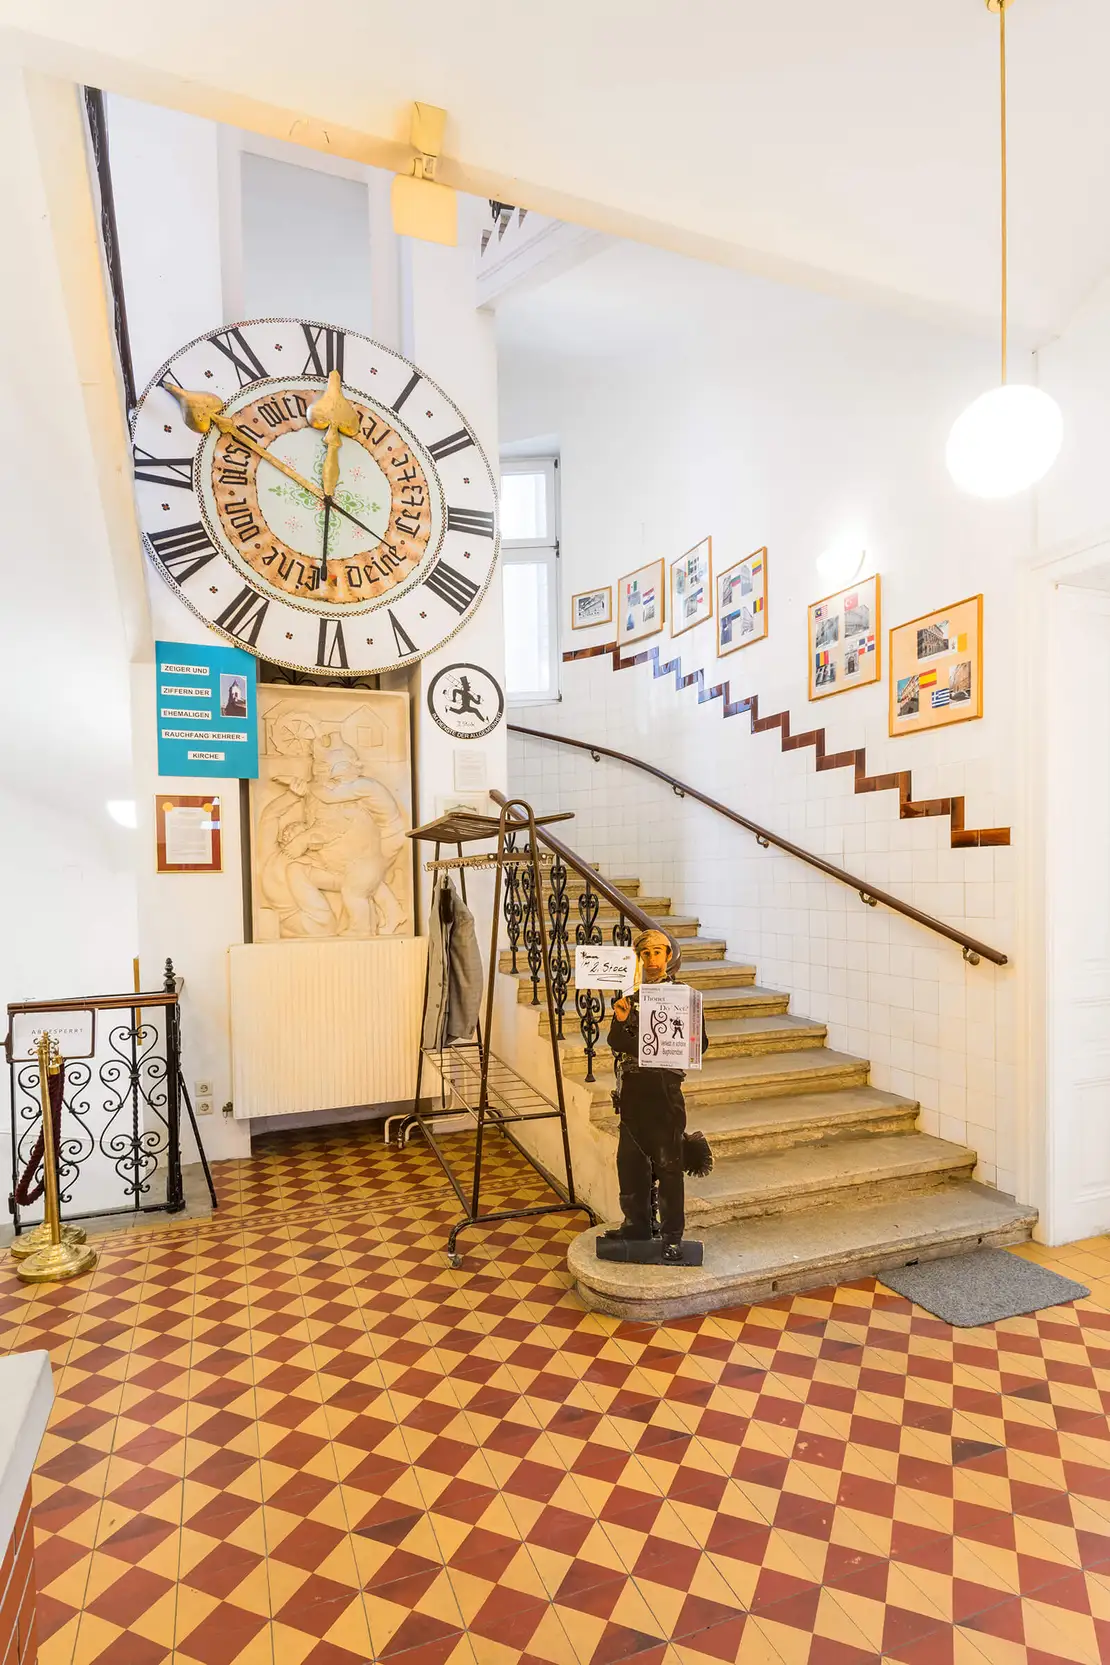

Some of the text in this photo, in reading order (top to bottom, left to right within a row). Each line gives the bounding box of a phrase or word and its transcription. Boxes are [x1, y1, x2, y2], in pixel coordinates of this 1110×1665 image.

[207, 327, 270, 389] XI
[300, 323, 346, 382] XII
[426, 427, 476, 462] II
[447, 505, 494, 539] III
[147, 521, 219, 587] VIII
[422, 558, 481, 616] IIII
[213, 584, 270, 648] VII
[387, 609, 420, 658] V
[315, 618, 350, 669] VI
[164, 665, 191, 673] ZEIGER
[163, 687, 193, 695] ZIFFERN
[163, 710, 210, 718] EHEMALIGEN
[164, 731, 209, 739] RAUCHFANG
[192, 752, 219, 760] KIRCHE
